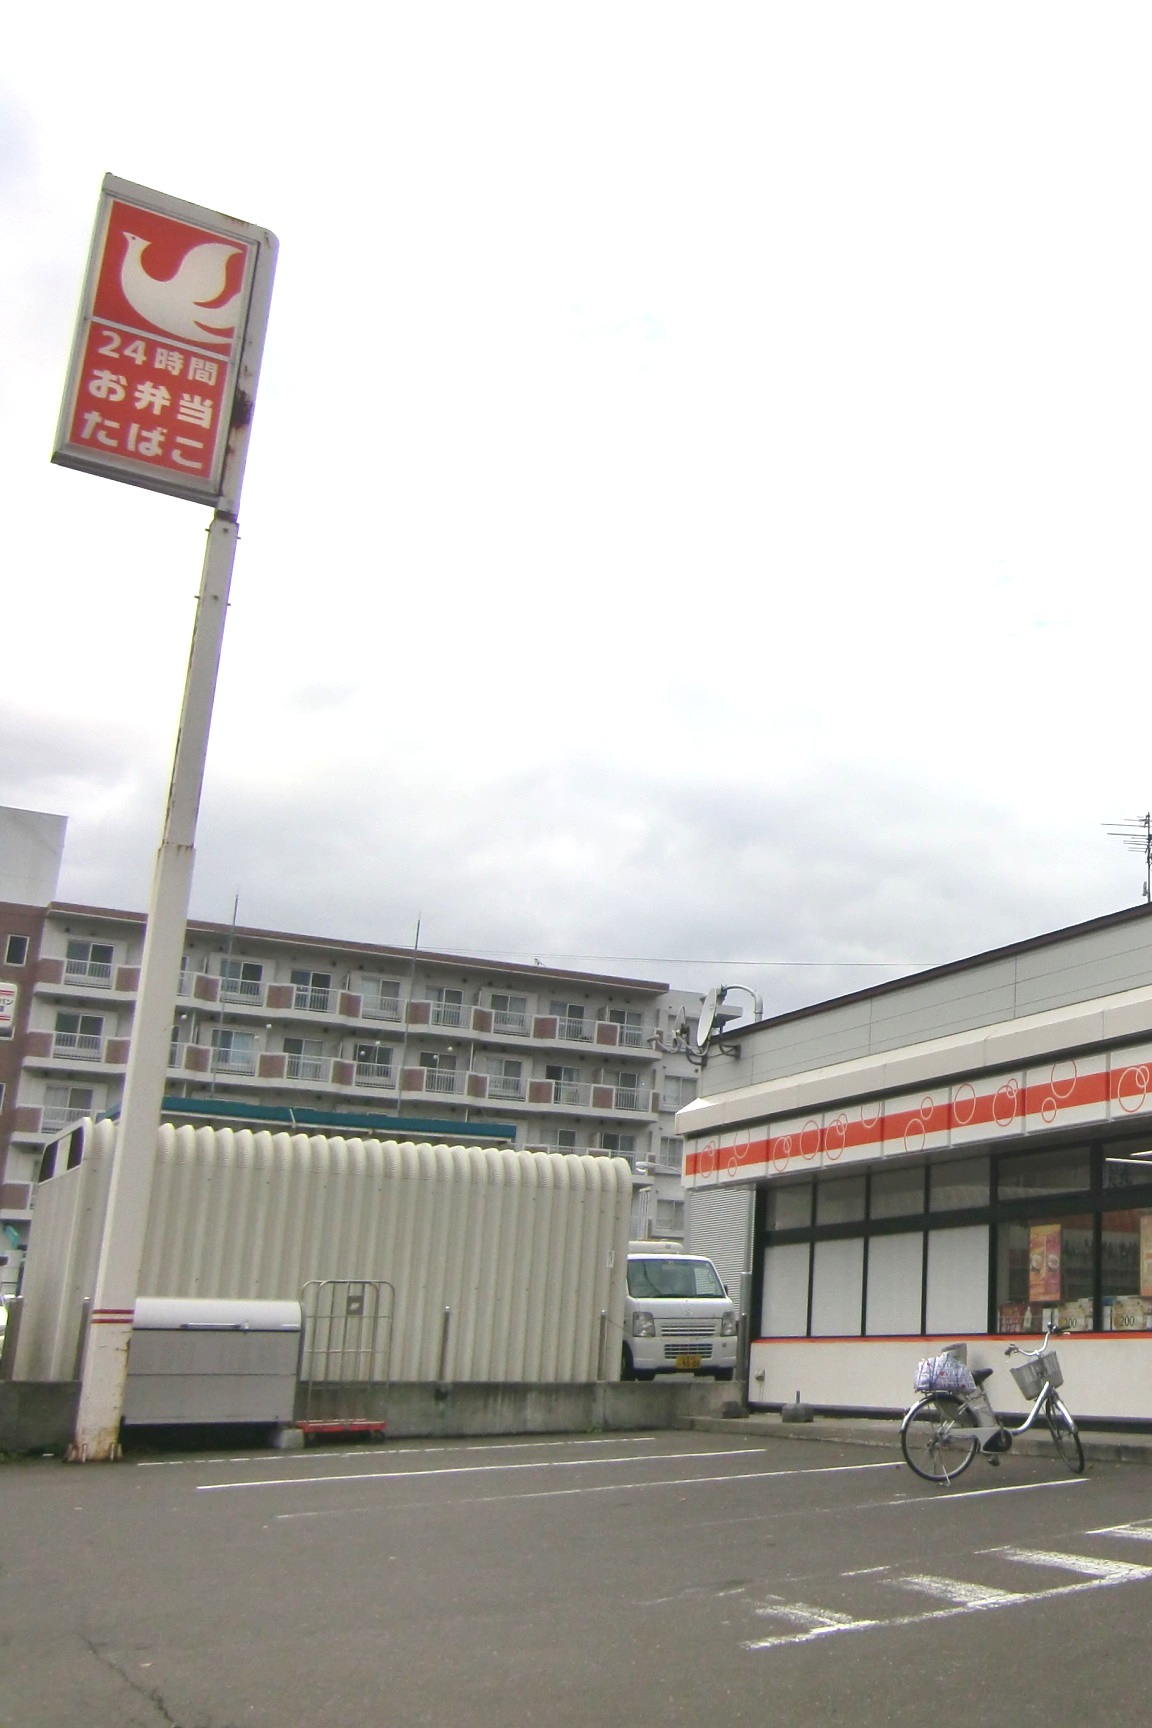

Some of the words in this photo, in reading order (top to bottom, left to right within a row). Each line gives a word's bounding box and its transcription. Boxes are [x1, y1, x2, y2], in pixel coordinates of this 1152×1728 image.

[98, 330, 218, 386] 24時間
[88, 368, 214, 429] お弁当
[80, 410, 205, 469] たばこ
[1119, 1314, 1135, 1327] 200
